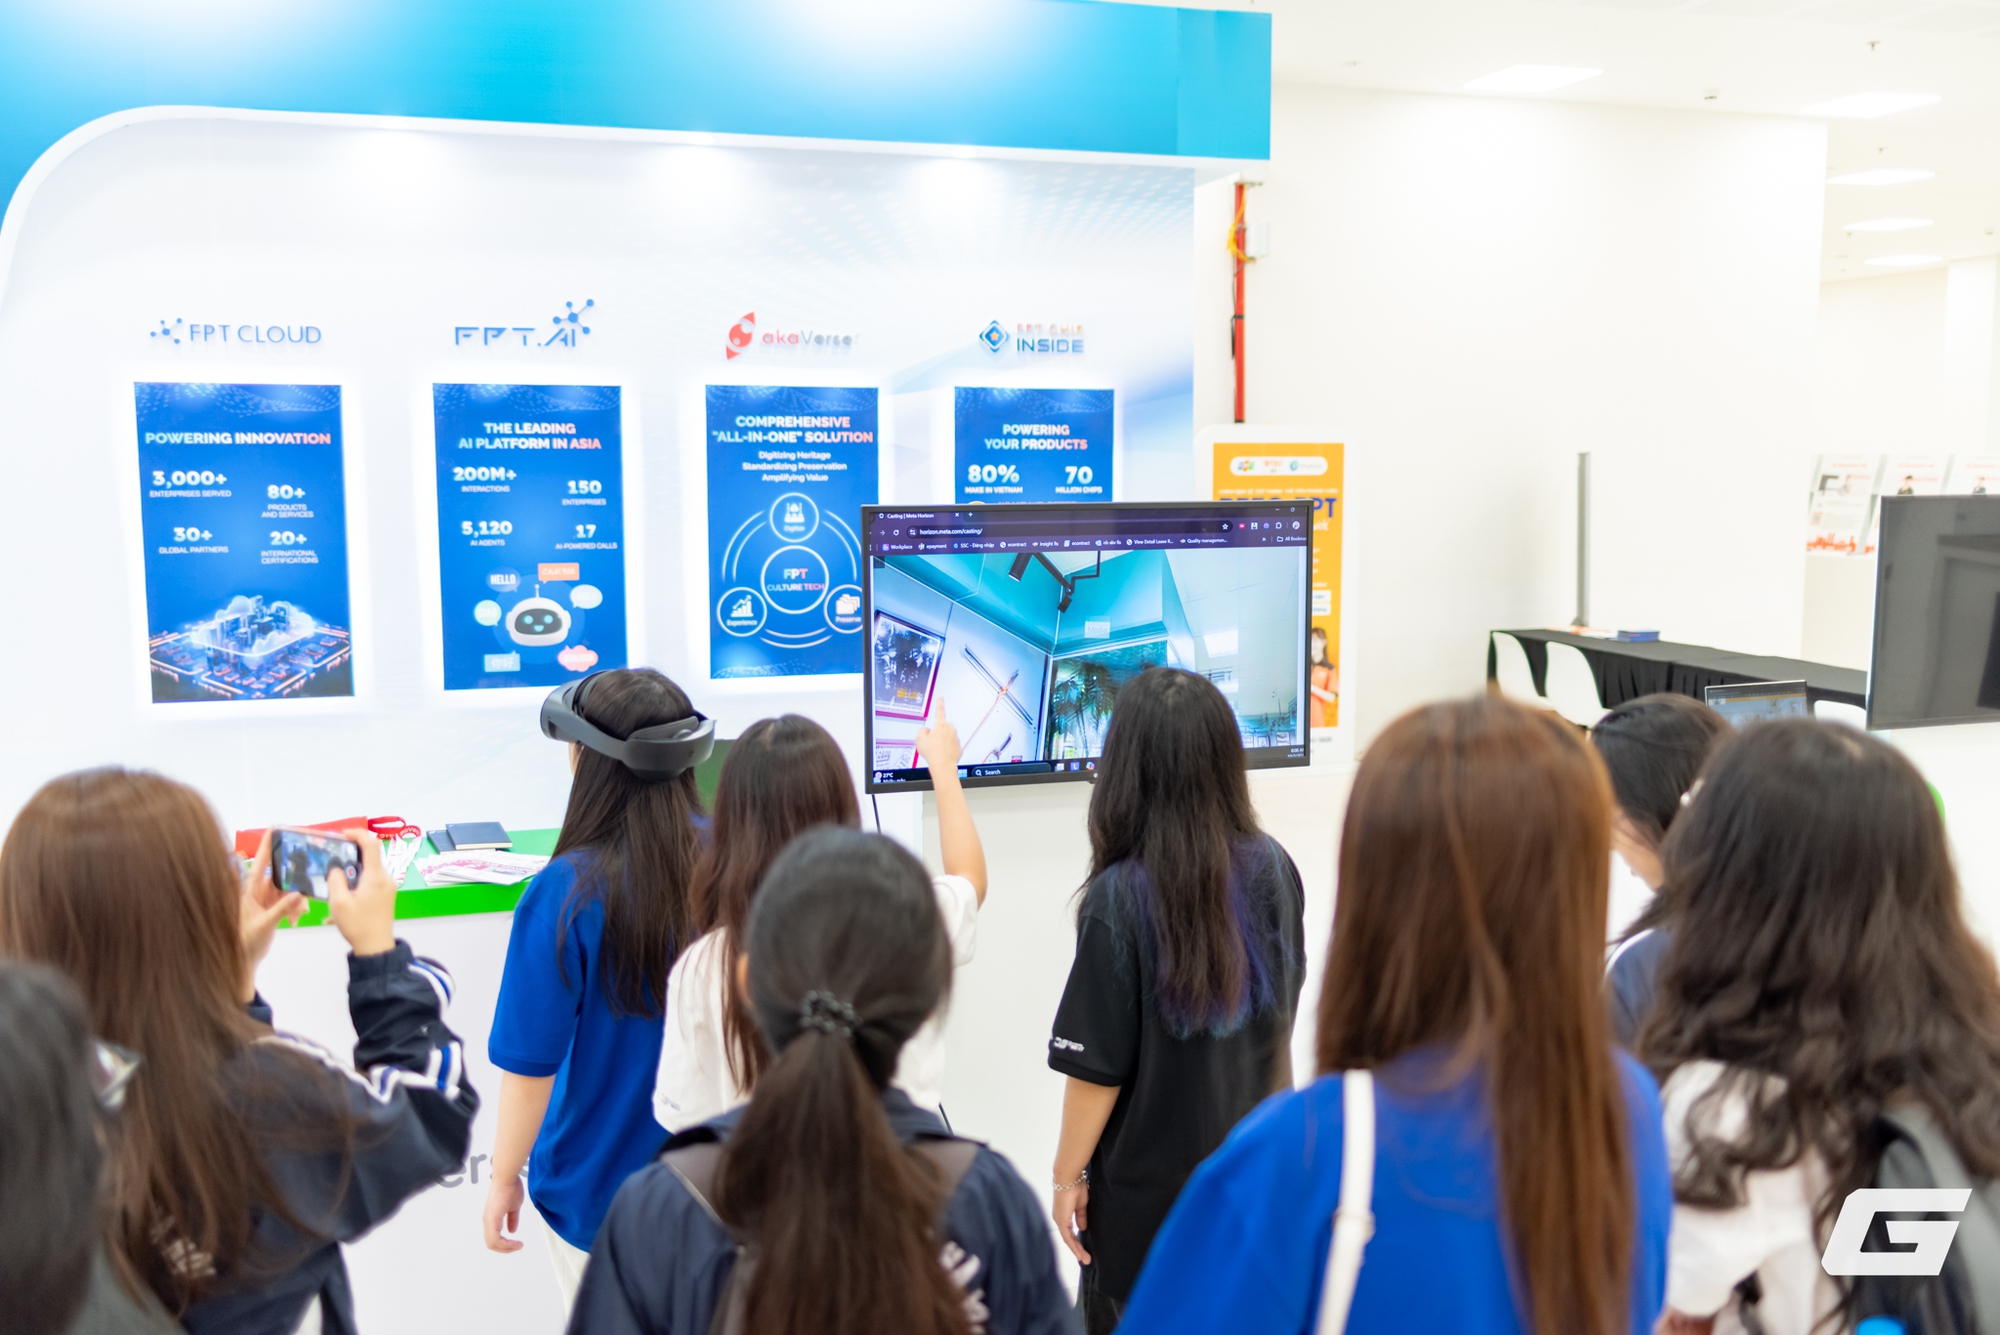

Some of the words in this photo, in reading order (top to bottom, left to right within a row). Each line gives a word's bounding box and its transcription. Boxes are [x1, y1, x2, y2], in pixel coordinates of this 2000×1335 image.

[189, 324, 230, 343] FPT
[237, 325, 322, 343] CLOUD
[1017, 323, 1041, 333] FPT
[1049, 324, 1084, 334] CHIP
[454, 326, 576, 347] FPT.AI
[762, 329, 853, 346] akaVerse
[1017, 338, 1084, 353] INSIDE
[735, 416, 851, 428] COMPREHENSIVE
[483, 422, 513, 434] THE
[515, 423, 576, 435] LEADING
[1002, 424, 1070, 436] POWERING
[145, 432, 232, 445] POWERING
[235, 432, 331, 445] INNOVATION
[712, 431, 803, 443] "ALL-IN-ONE"
[804, 431, 873, 443] SOLUTION
[458, 438, 473, 449] AI
[476, 438, 550, 449] PLATFORM
[552, 438, 568, 449] IN
[570, 438, 602, 450] ASIA
[984, 438, 1020, 450] YOUR
[1021, 439, 1088, 450] PRODUCTS
[758, 451, 796, 460] Digitizing
[797, 451, 831, 460] Heritage
[742, 462, 797, 471] Standardizing
[798, 462, 847, 470] Preservation
[152, 470, 227, 489] 3,000+
[453, 466, 517, 482] 200M+
[762, 474, 805, 483] Amplifying
[967, 464, 1020, 484] 80%
[1065, 465, 1094, 485] 70
[150, 490, 201, 498] ENTERPRISES
[202, 489, 232, 498] SERVED
[267, 484, 306, 500] 80+
[461, 485, 510, 493] INTERACTIONS
[567, 480, 602, 495] 150
[965, 486, 985, 494] MAKE
[985, 486, 993, 494] IN
[994, 486, 1023, 494] VIETNAM
[1055, 486, 1082, 494] MILLION
[1083, 486, 1103, 494] CHIPS
[267, 503, 307, 512] PRODUCTS
[562, 498, 606, 506] ENTERPRISES
[279, 510, 314, 518] SERVICES
[173, 526, 213, 543] 30+
[461, 520, 513, 538] 5,120
[575, 524, 597, 538] 17
[919, 527, 983, 536] horizon.meta.com/casting/
[269, 530, 307, 546] 20+
[1187, 537, 1199, 545] Quality
[159, 546, 189, 555] GLOBAL
[190, 546, 229, 554] PARTNERS
[597, 542, 618, 550] CALLS
[261, 556, 319, 564] CERTIFICATIONS
[490, 573, 516, 585] HELLO
[783, 568, 808, 580] FPT
[766, 584, 803, 592] CULTURE
[804, 583, 825, 591] TECH
[835, 615, 862, 623] Preserve
